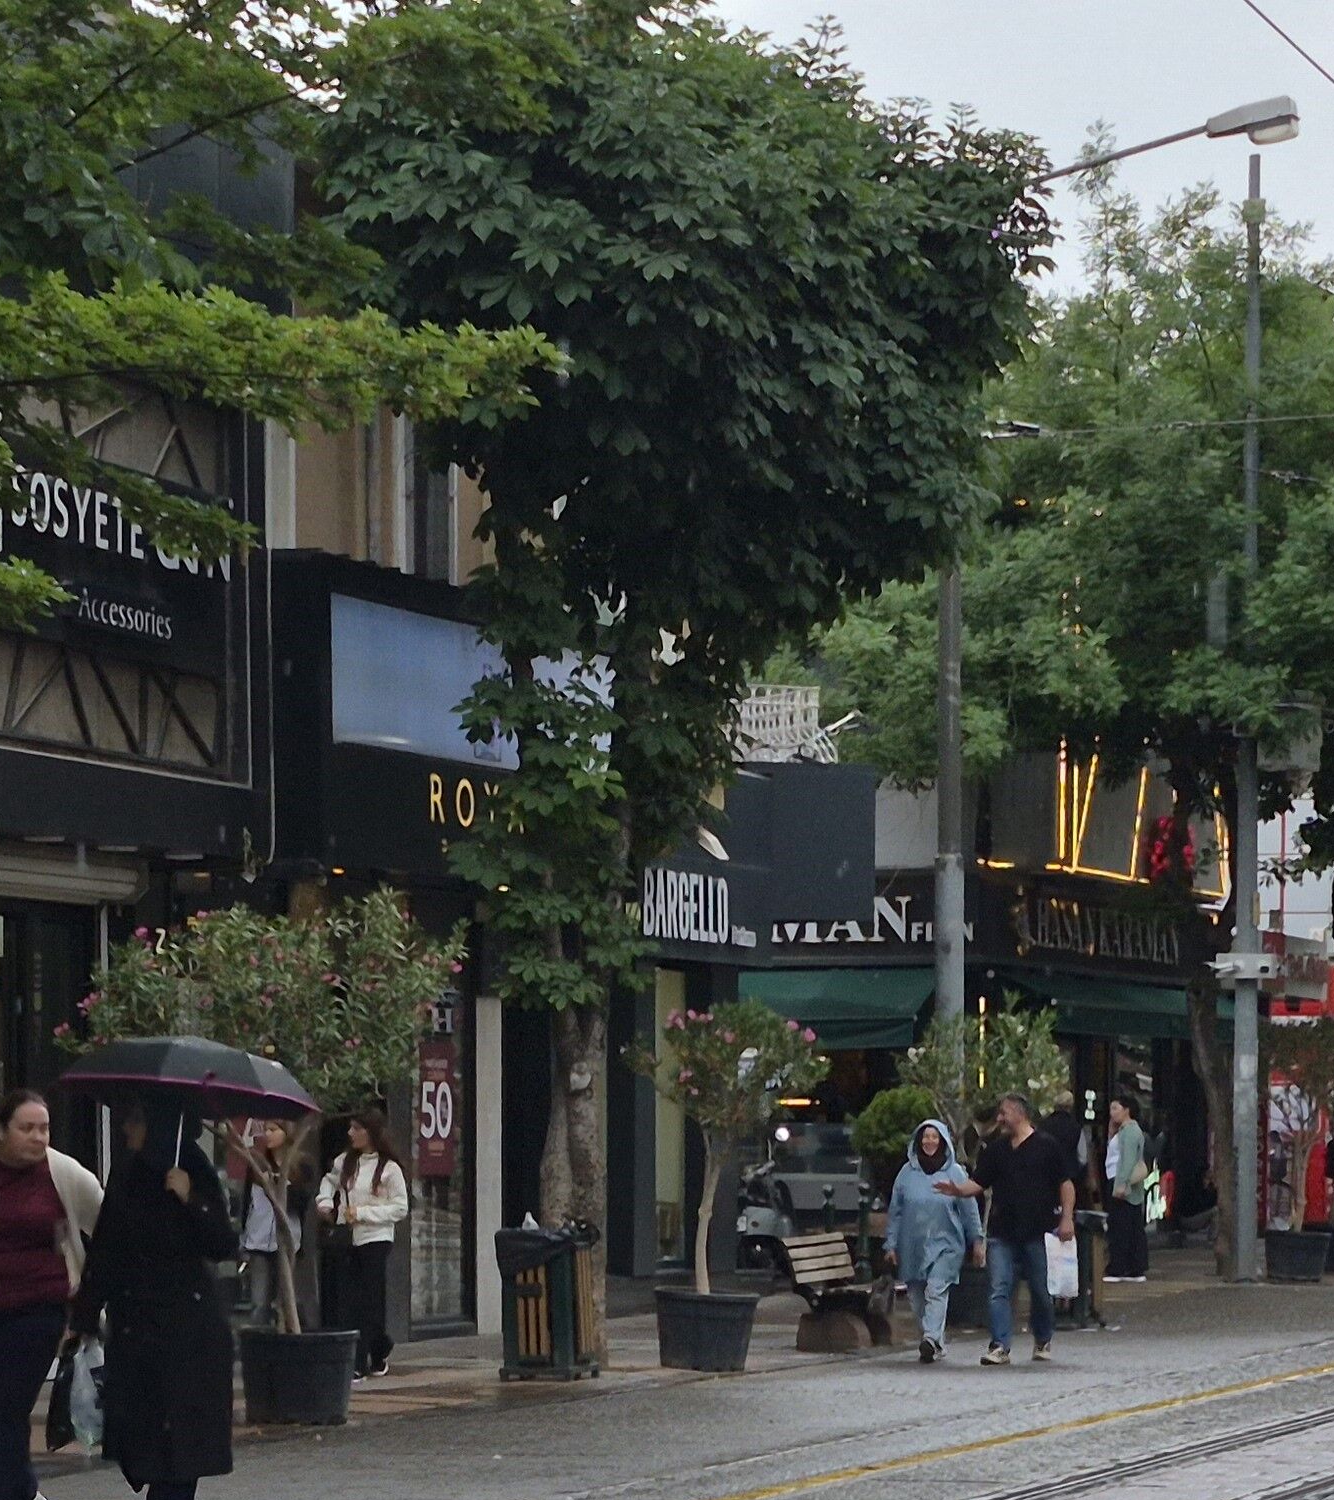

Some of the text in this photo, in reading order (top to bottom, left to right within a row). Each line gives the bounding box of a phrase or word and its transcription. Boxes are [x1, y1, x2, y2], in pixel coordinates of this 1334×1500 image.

[78, 587, 173, 640] Accessories
[643, 866, 729, 944] BARGELLO
[420, 1080, 453, 1139] 50
